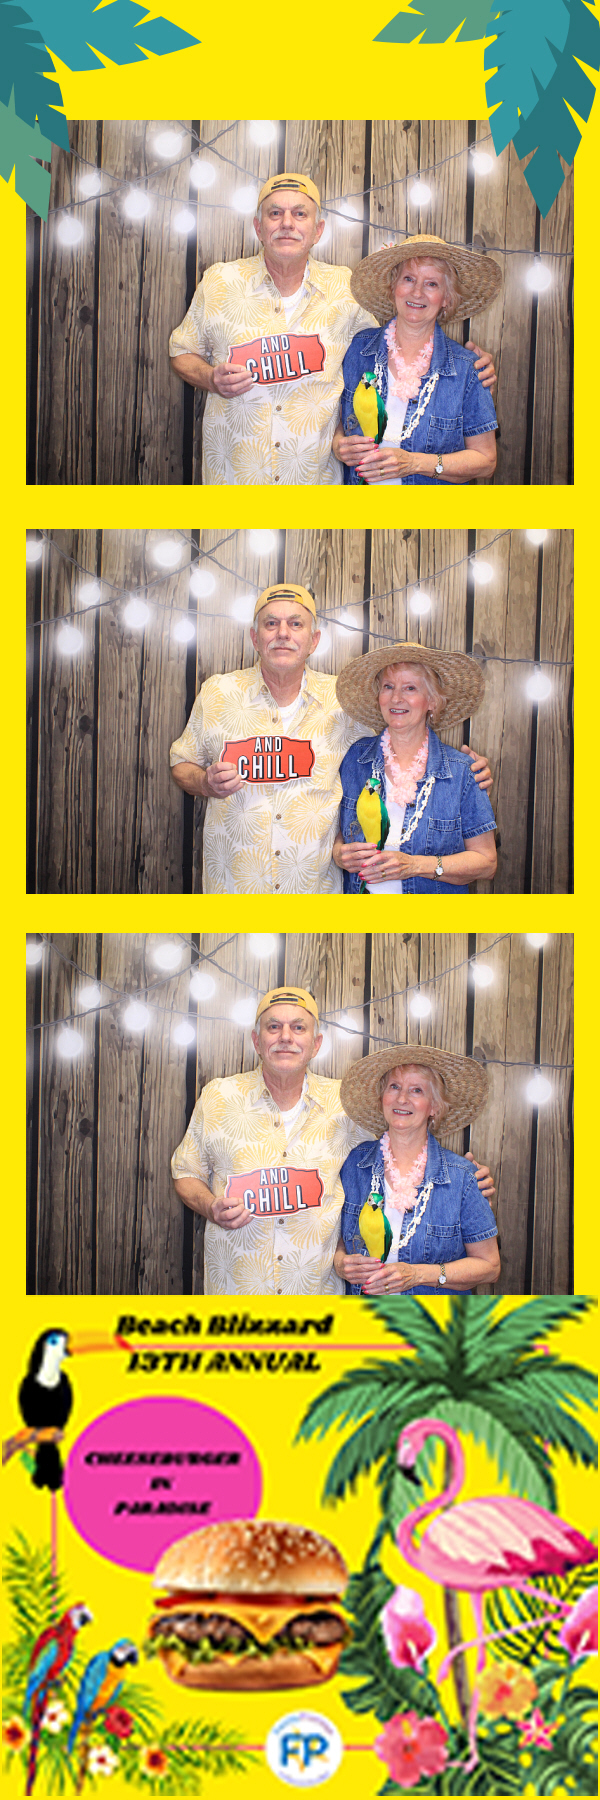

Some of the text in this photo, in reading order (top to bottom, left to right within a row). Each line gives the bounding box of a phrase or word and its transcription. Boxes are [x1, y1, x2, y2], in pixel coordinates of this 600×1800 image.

[261, 335, 290, 354] AND
[246, 351, 311, 382] CHILL
[254, 736, 283, 753] AND
[237, 755, 299, 779] CHILL
[260, 1167, 289, 1185] AND
[243, 1185, 308, 1214] CHILL
